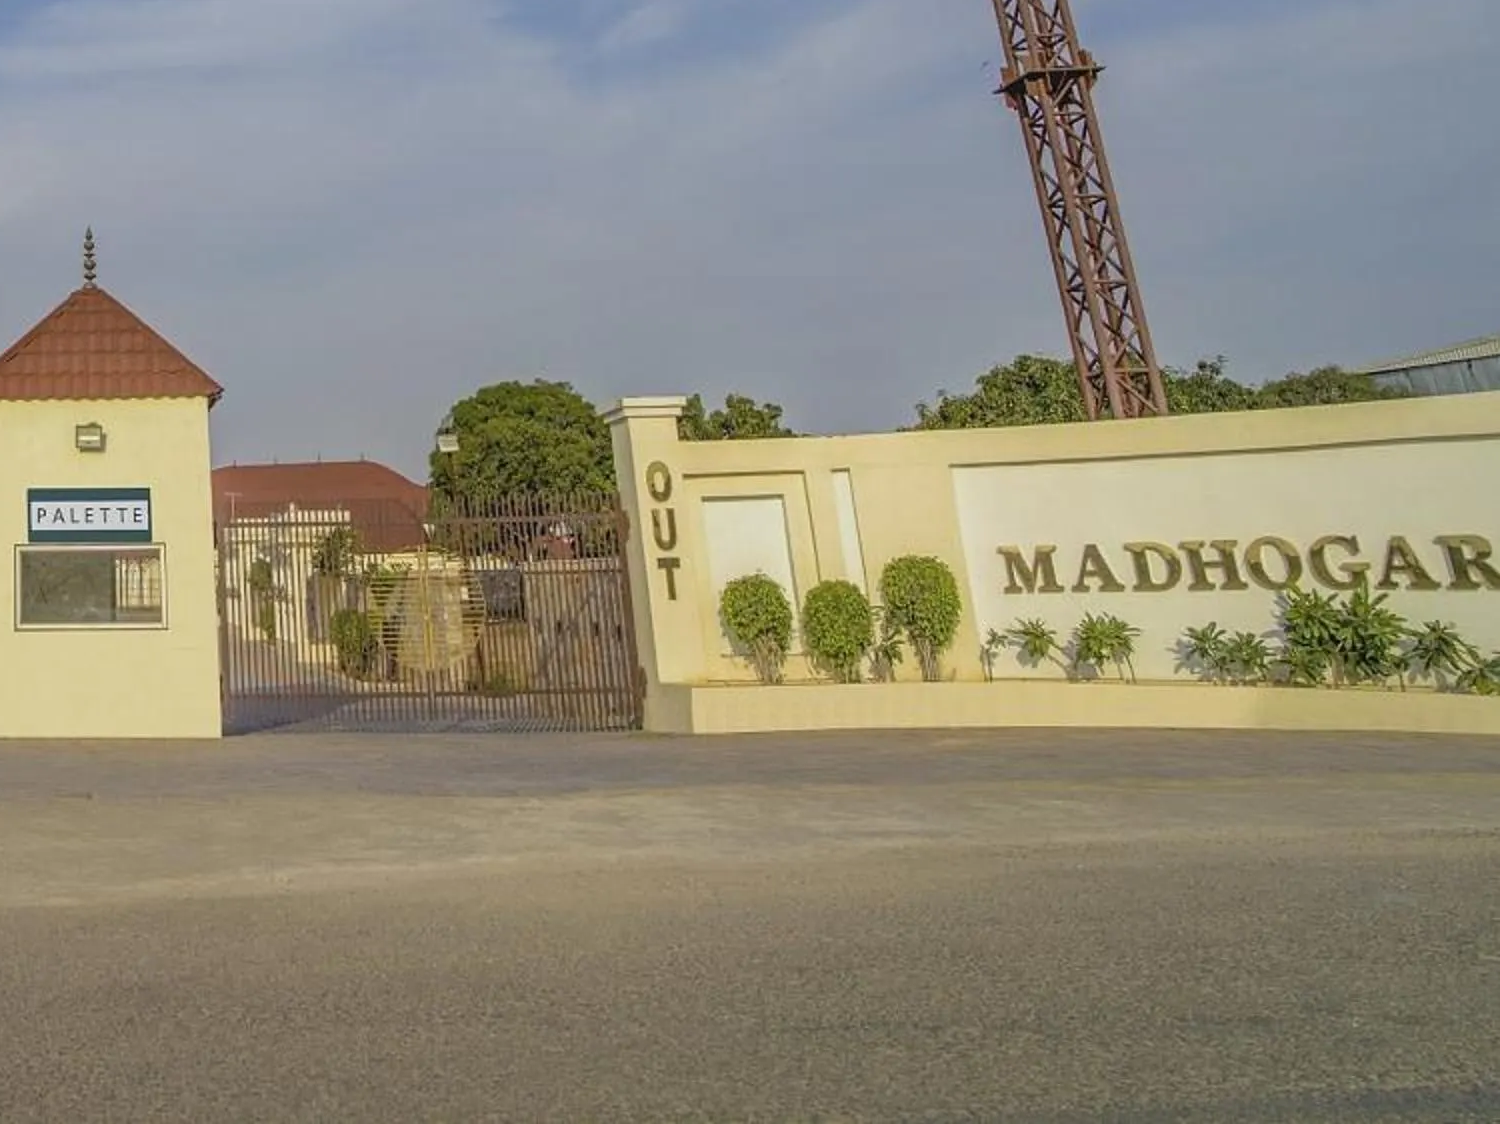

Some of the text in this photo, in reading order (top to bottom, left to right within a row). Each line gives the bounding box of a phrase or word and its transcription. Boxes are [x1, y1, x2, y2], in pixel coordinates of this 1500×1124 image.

[36, 507, 144, 524] PALETTE
[645, 460, 681, 601] OUT
[996, 533, 1500, 594] MADHOGAR
